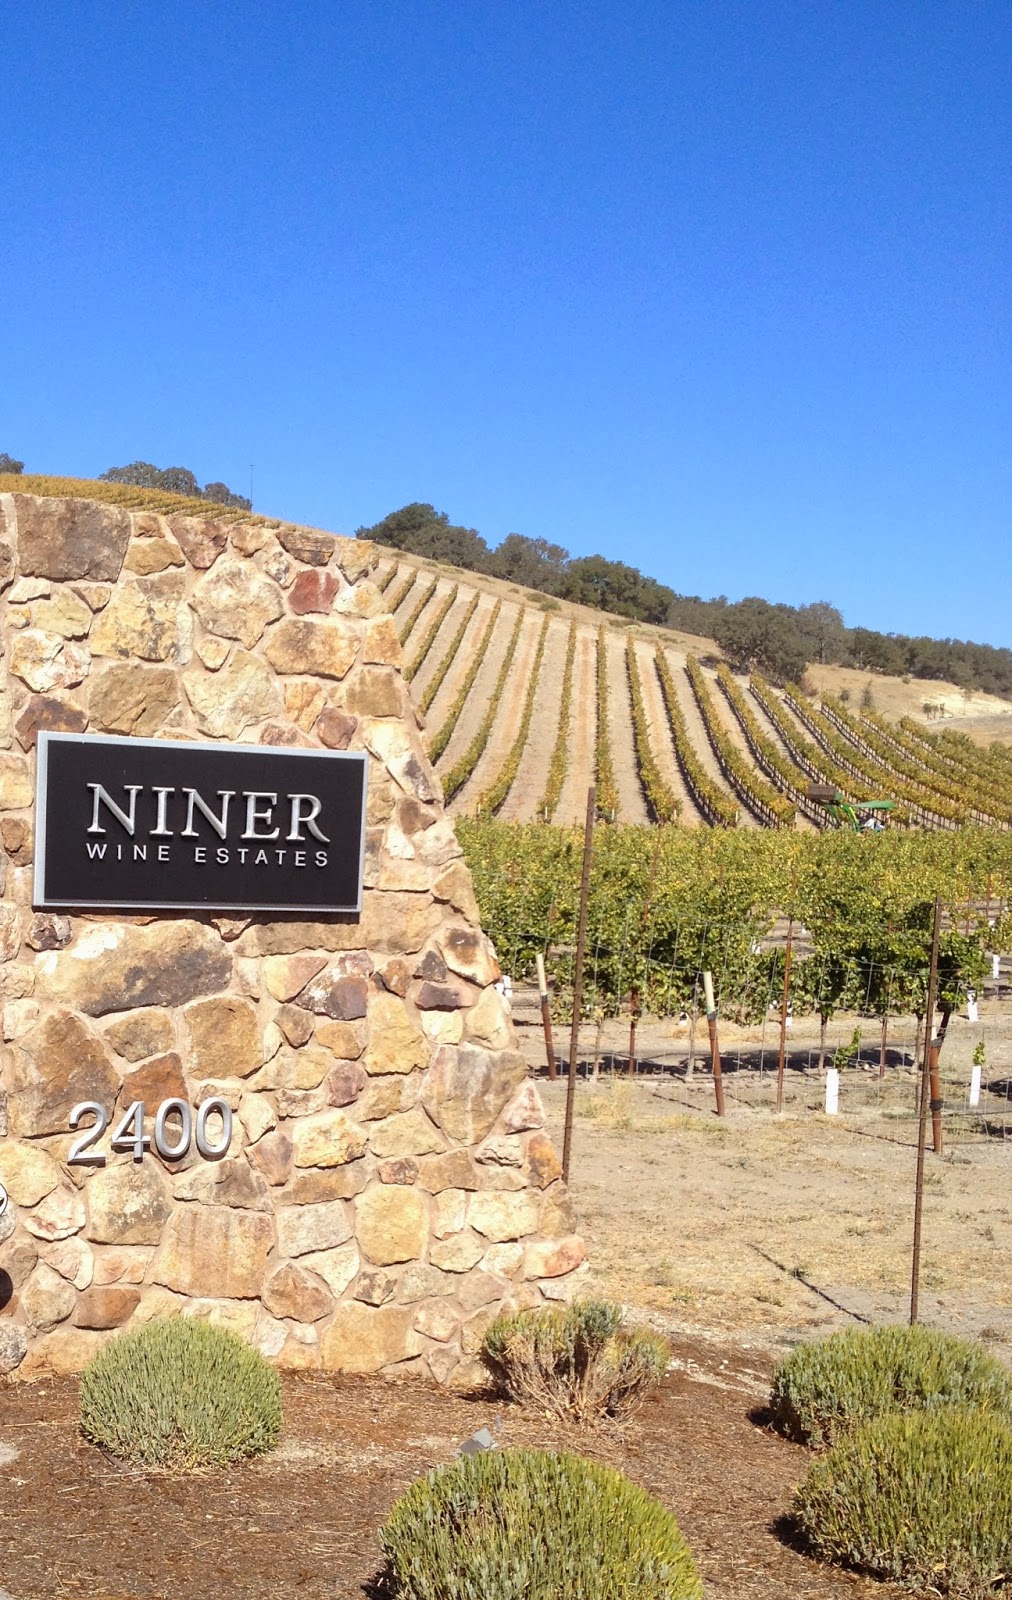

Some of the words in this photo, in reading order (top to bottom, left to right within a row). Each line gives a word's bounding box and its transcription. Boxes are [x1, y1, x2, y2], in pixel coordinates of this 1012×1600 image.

[86, 783, 330, 843] NINER
[86, 842, 171, 862] WINE
[194, 847, 329, 867] ESTATES
[67, 1097, 233, 1163] 2400
